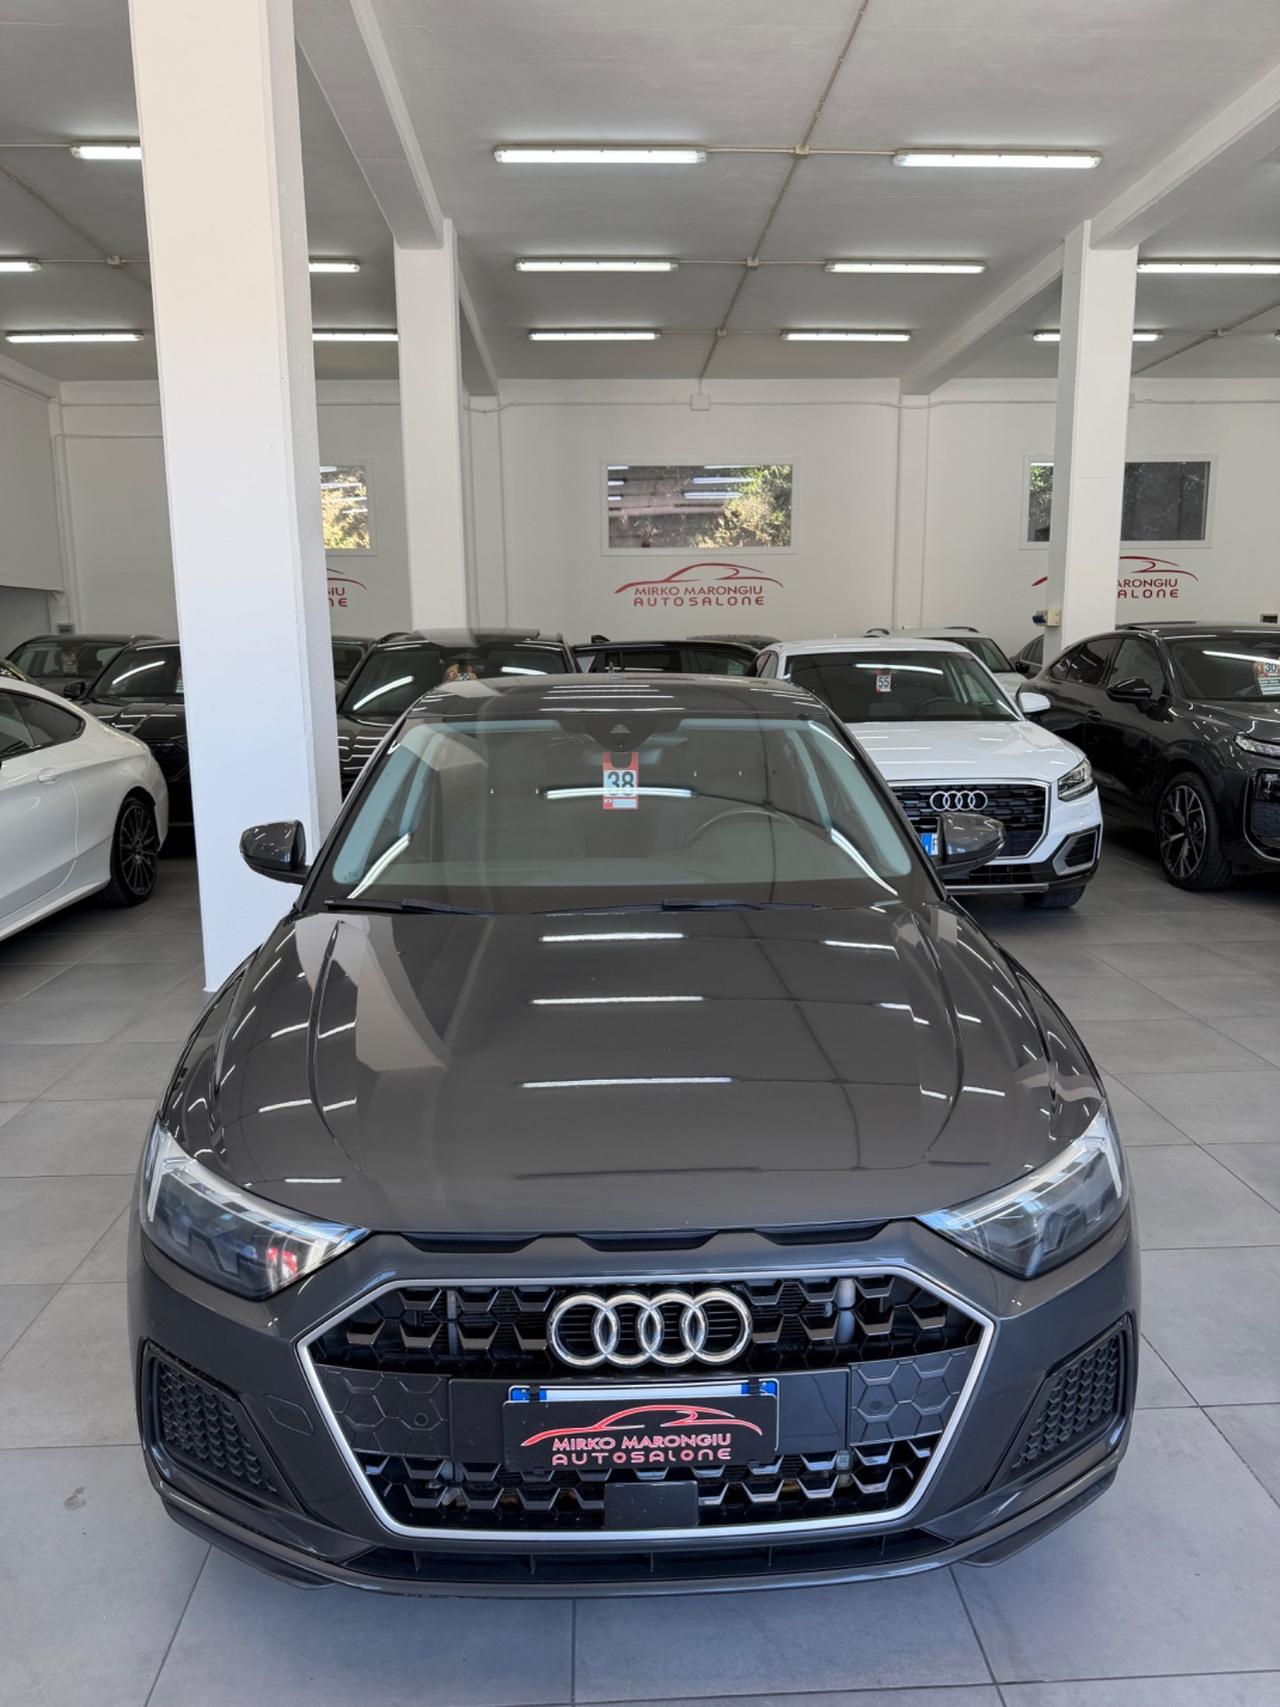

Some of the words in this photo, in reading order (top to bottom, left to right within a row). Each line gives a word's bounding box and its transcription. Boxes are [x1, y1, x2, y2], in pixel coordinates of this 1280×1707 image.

[634, 586, 680, 596] MIRKO
[684, 585, 763, 596] MARONGIU
[633, 596, 765, 607] AUTOSALONE
[607, 771, 635, 796] 38
[552, 1435, 616, 1451] MIRKO
[621, 1433, 732, 1450] MARONGIU
[551, 1448, 732, 1465] AUTOSALONE
